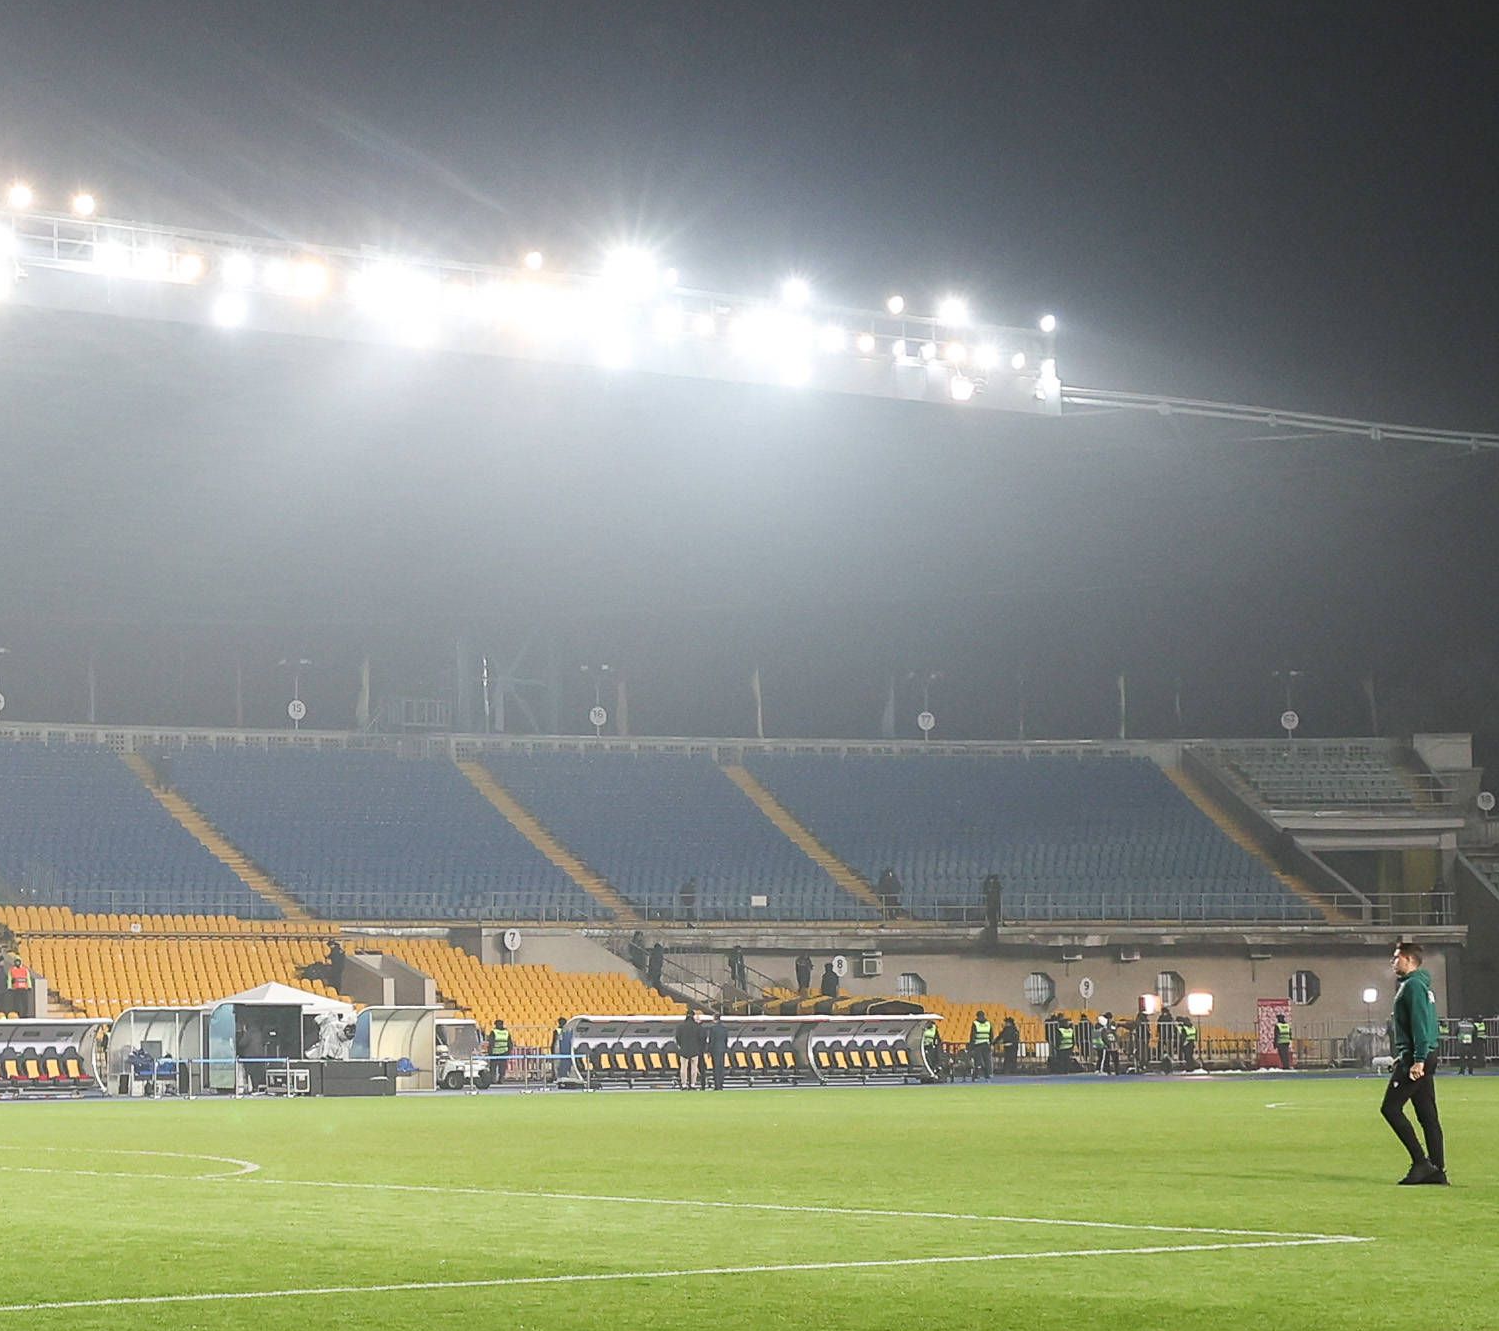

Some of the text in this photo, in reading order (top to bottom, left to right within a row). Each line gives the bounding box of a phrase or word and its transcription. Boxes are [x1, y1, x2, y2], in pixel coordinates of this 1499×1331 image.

[292, 703, 302, 713] 15
[837, 959, 843, 969] 8
[1084, 981, 1090, 990] 9
